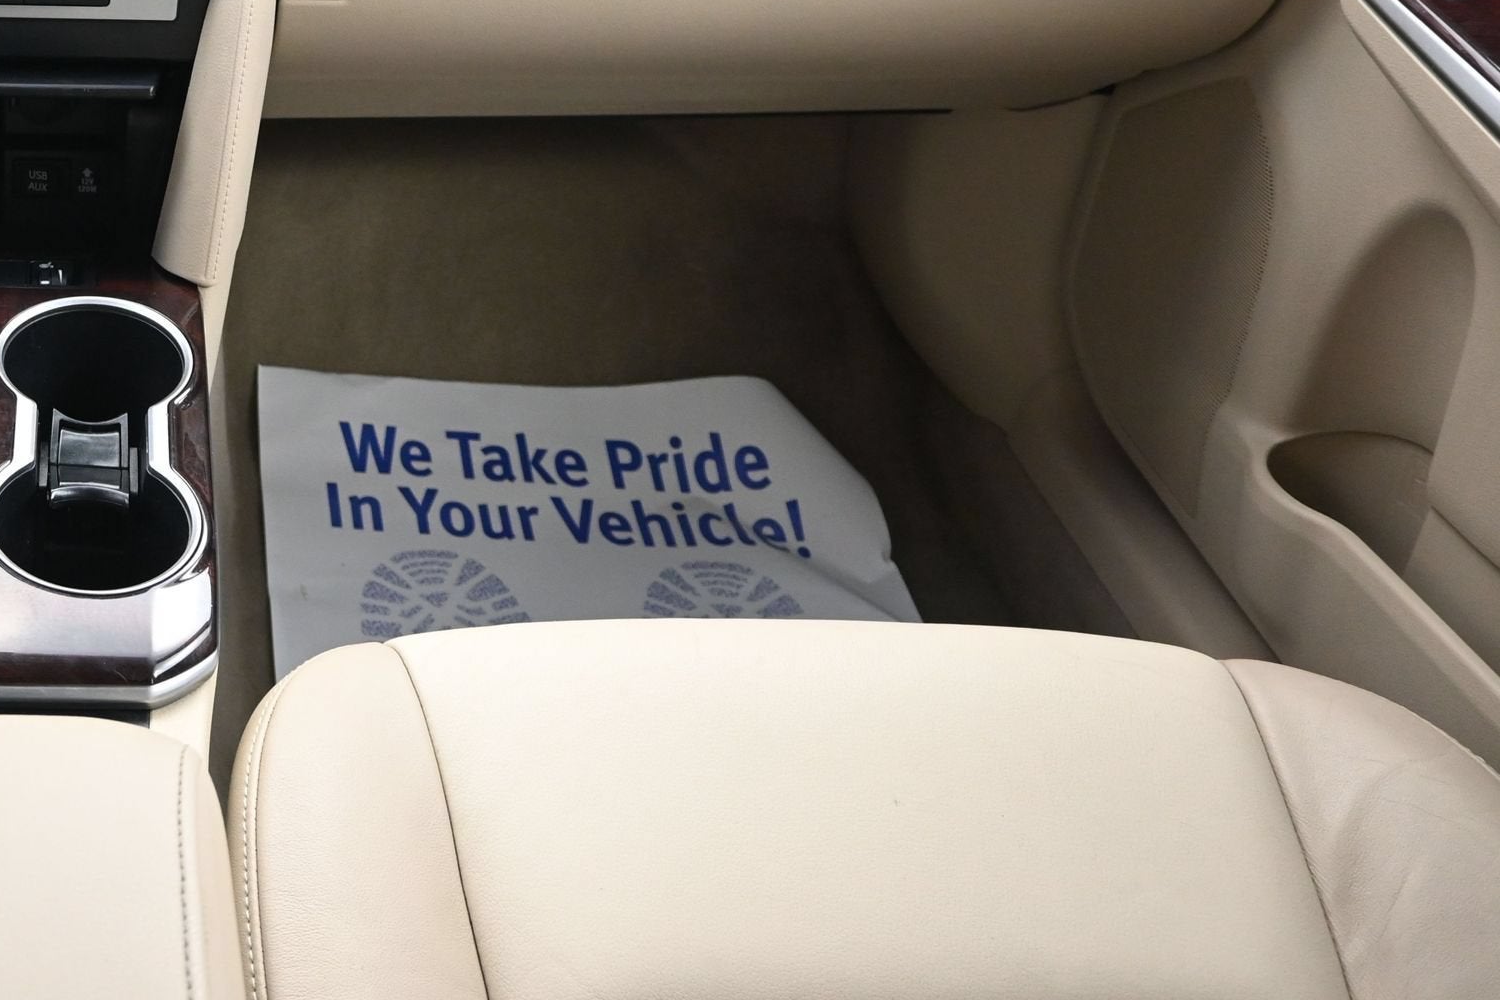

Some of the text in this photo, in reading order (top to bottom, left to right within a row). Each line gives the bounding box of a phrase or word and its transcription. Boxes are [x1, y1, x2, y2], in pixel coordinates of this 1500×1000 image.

[28, 169, 48, 180] USB
[28, 182, 48, 192] AUX
[338, 420, 770, 494] We Take Pride
[325, 482, 812, 560] In Your Vehicle!
